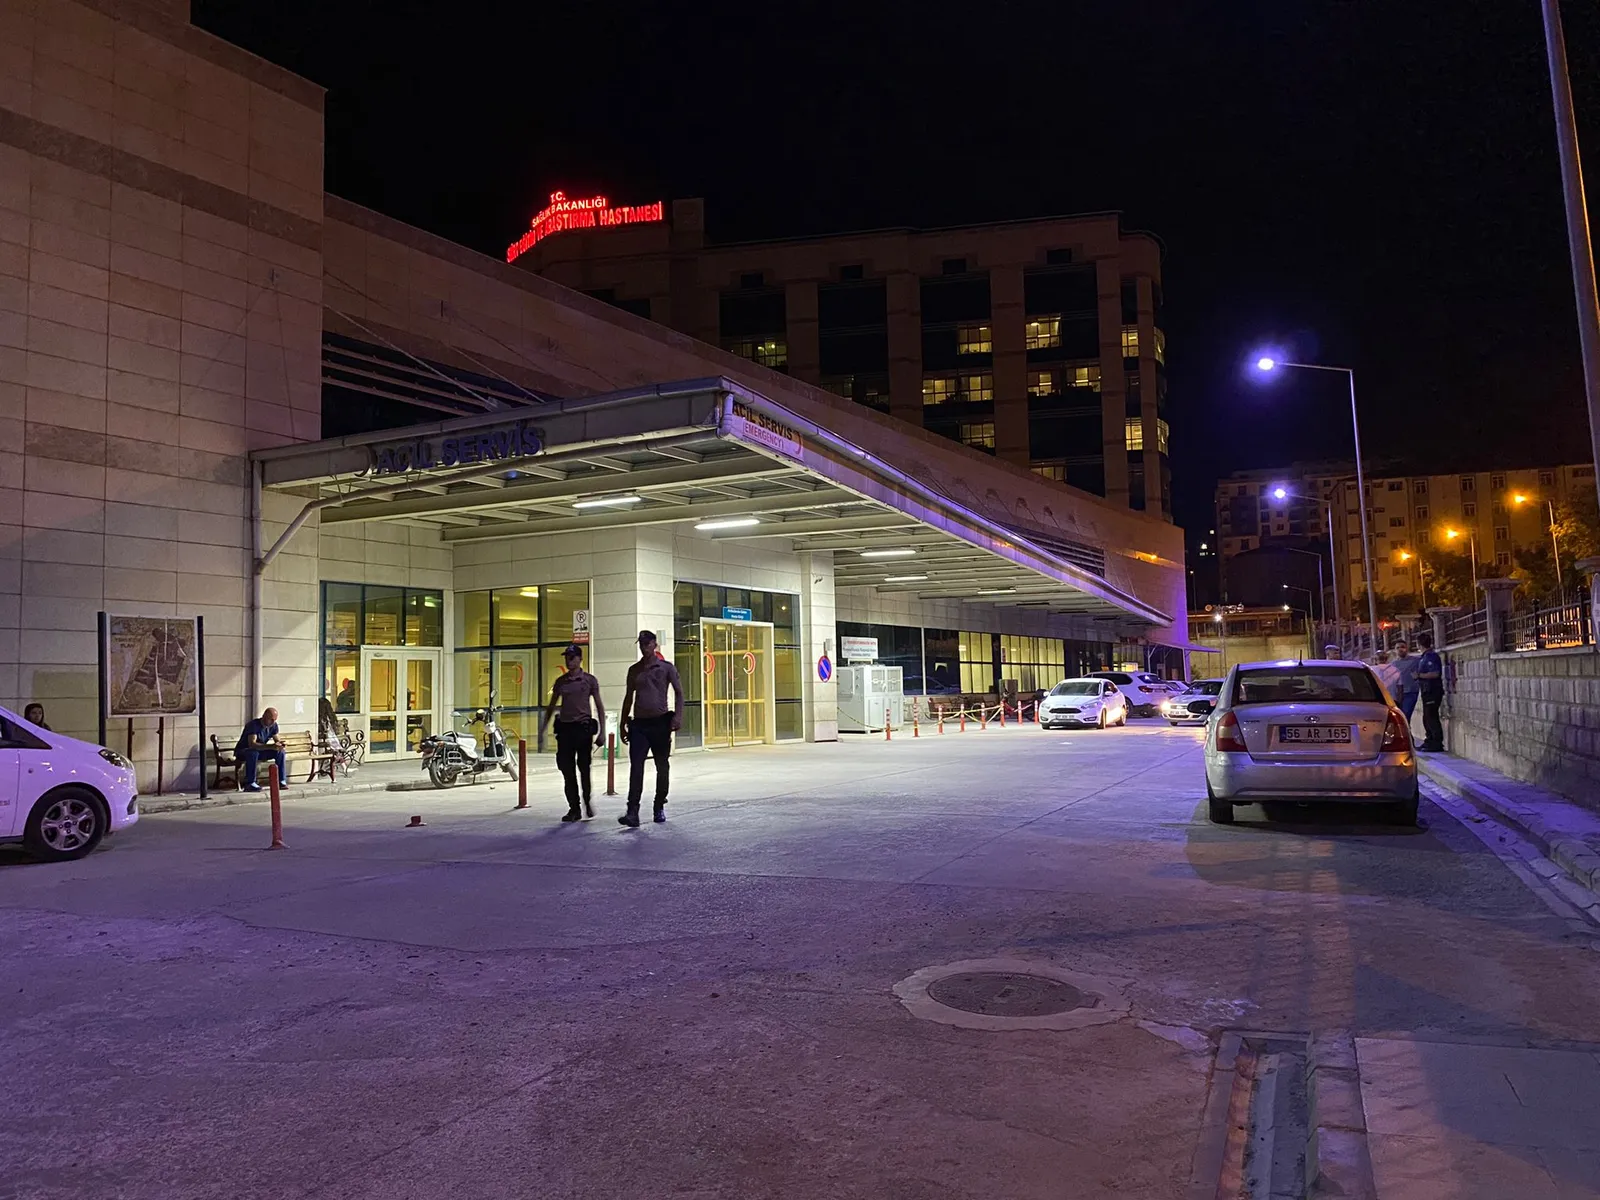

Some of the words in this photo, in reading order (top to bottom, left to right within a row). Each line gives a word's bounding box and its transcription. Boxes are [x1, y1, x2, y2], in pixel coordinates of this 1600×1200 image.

[545, 211, 596, 236] ARAŞTIRMA
[600, 200, 663, 226] HASTANESİ
[551, 196, 606, 214] BAKANLIĞI
[441, 420, 544, 467] SERVİS
[1286, 728, 1301, 739] 56
[1307, 728, 1320, 739] AR
[1327, 728, 1348, 739] 165
